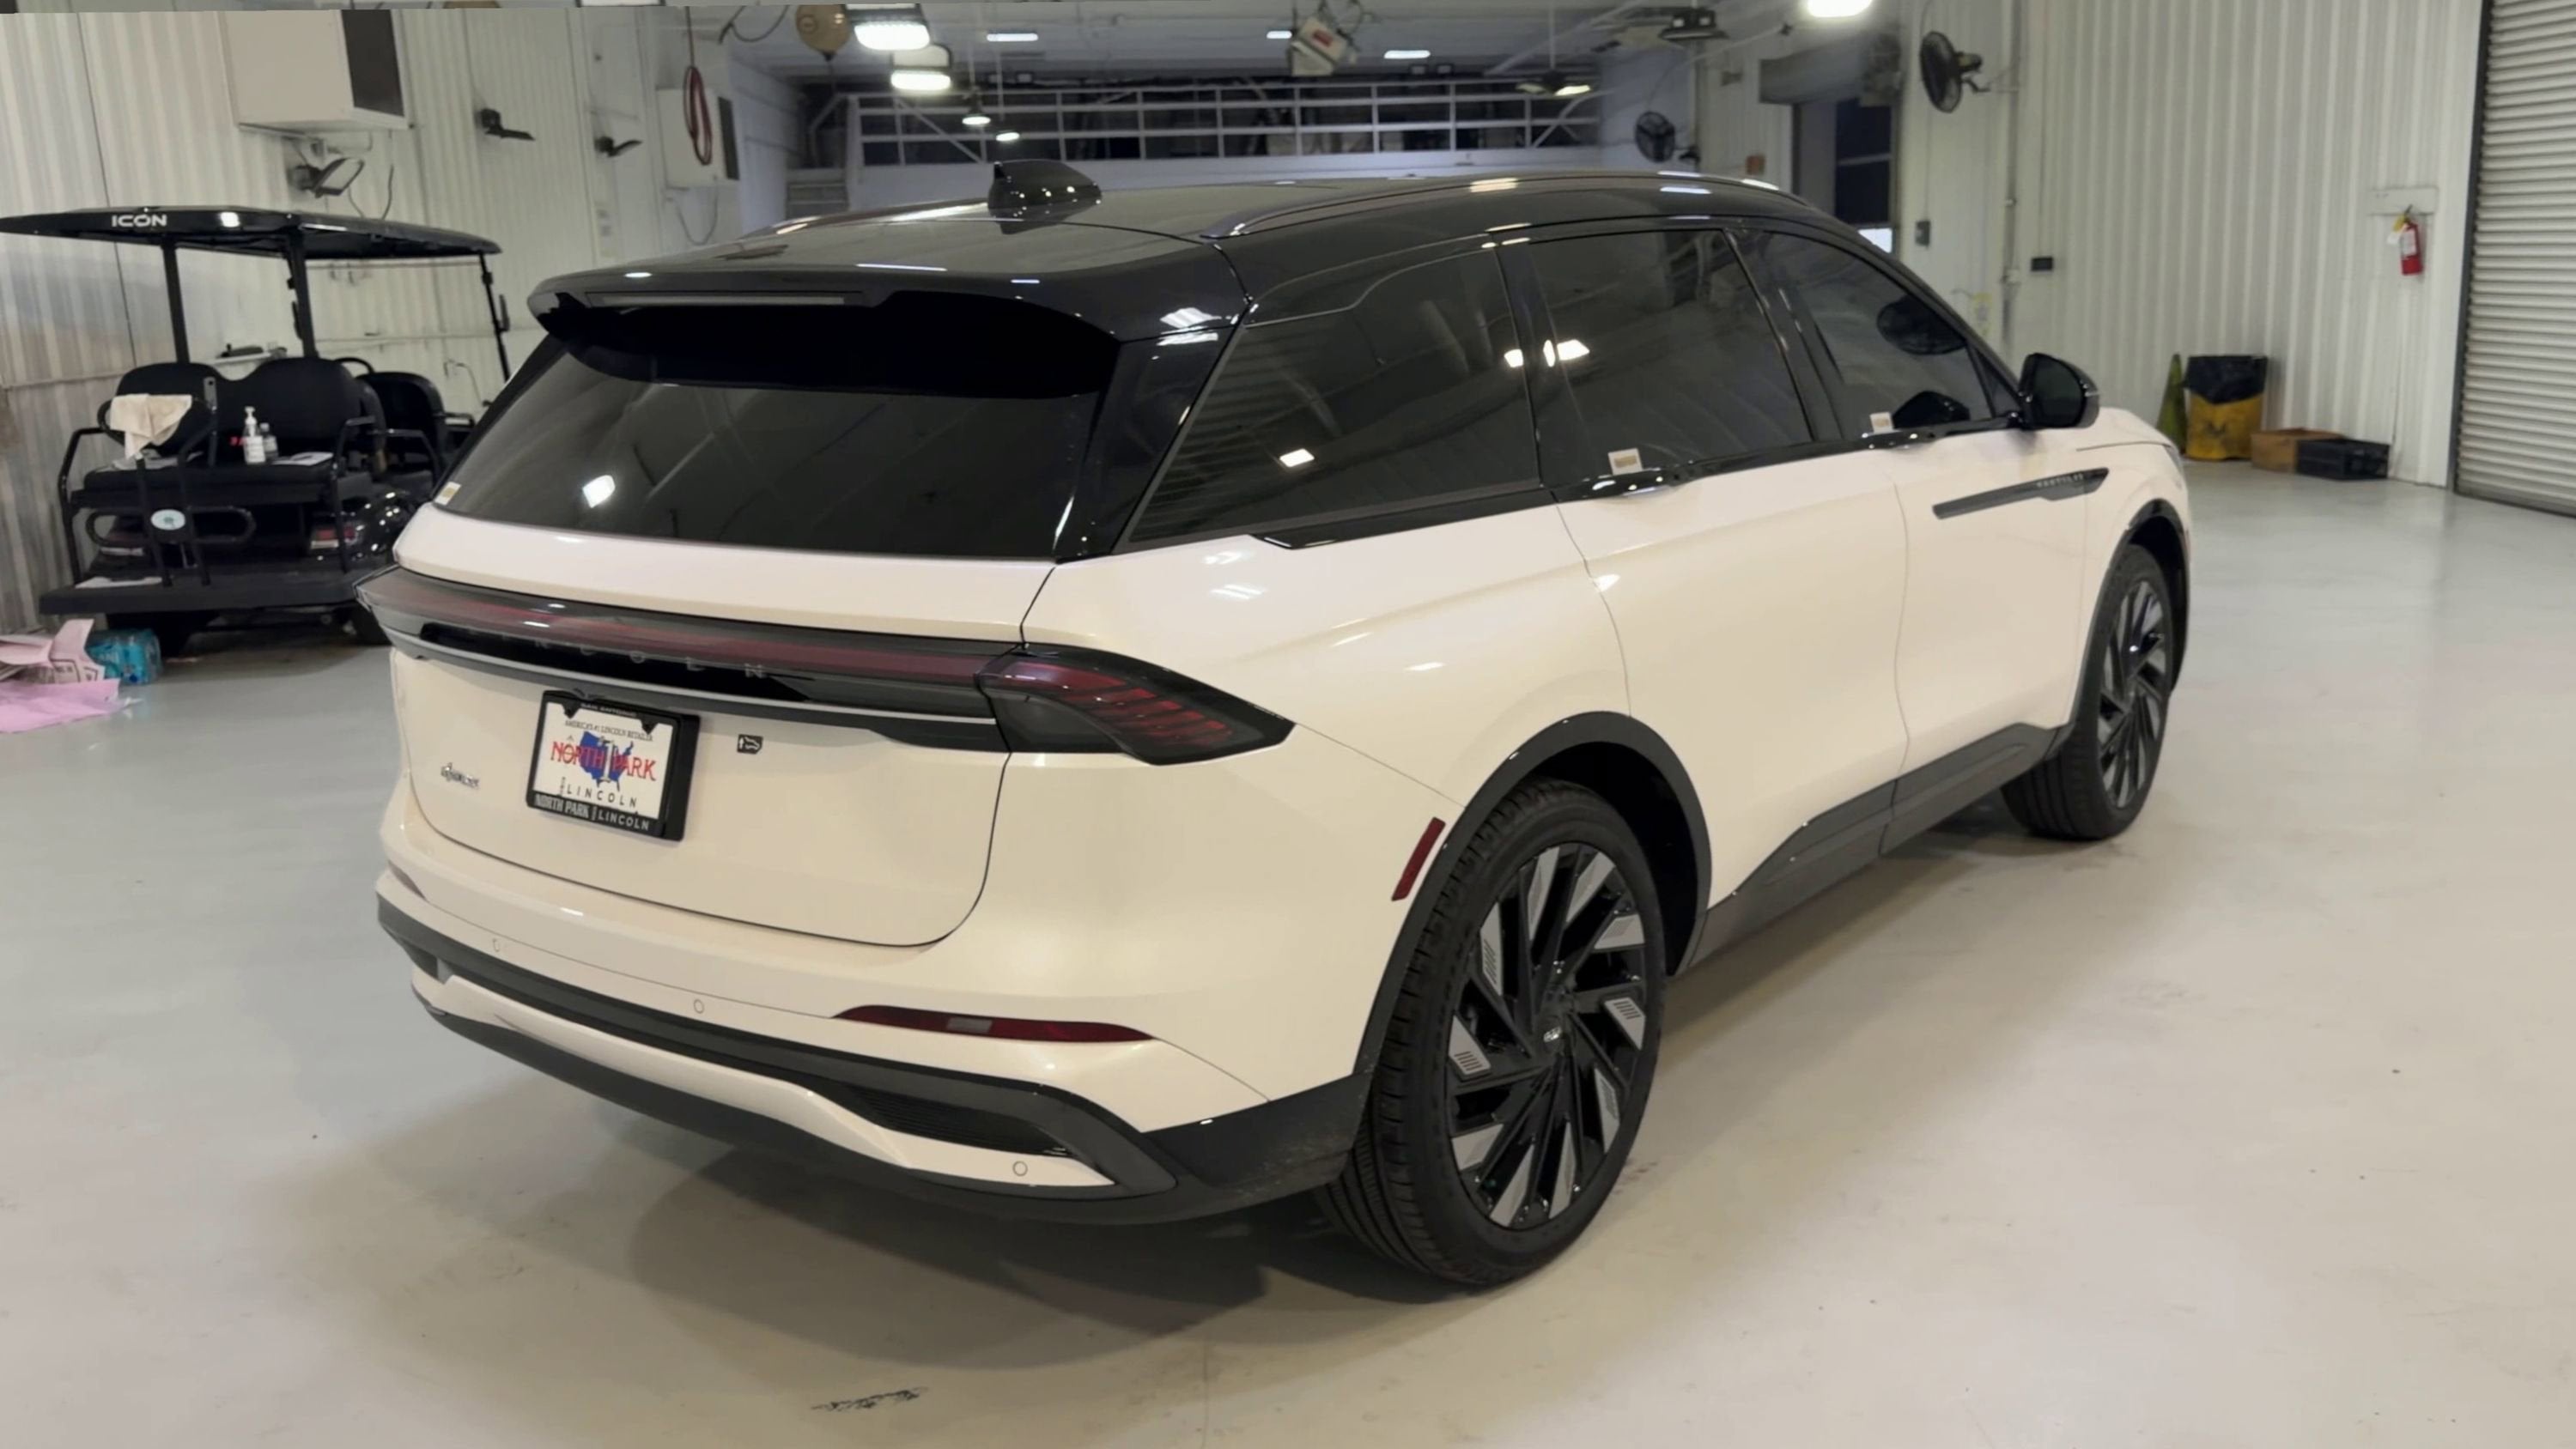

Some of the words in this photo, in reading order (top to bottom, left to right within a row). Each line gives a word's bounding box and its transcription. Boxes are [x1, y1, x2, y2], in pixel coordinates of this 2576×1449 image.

[112, 214, 167, 227] ICON
[550, 741, 607, 770] NORTH
[612, 749, 657, 781] PARK
[533, 792, 564, 812] NORTH
[565, 799, 591, 818] PARK
[597, 809, 650, 831] LINCOLN
[567, 784, 637, 808] LINCOLN
